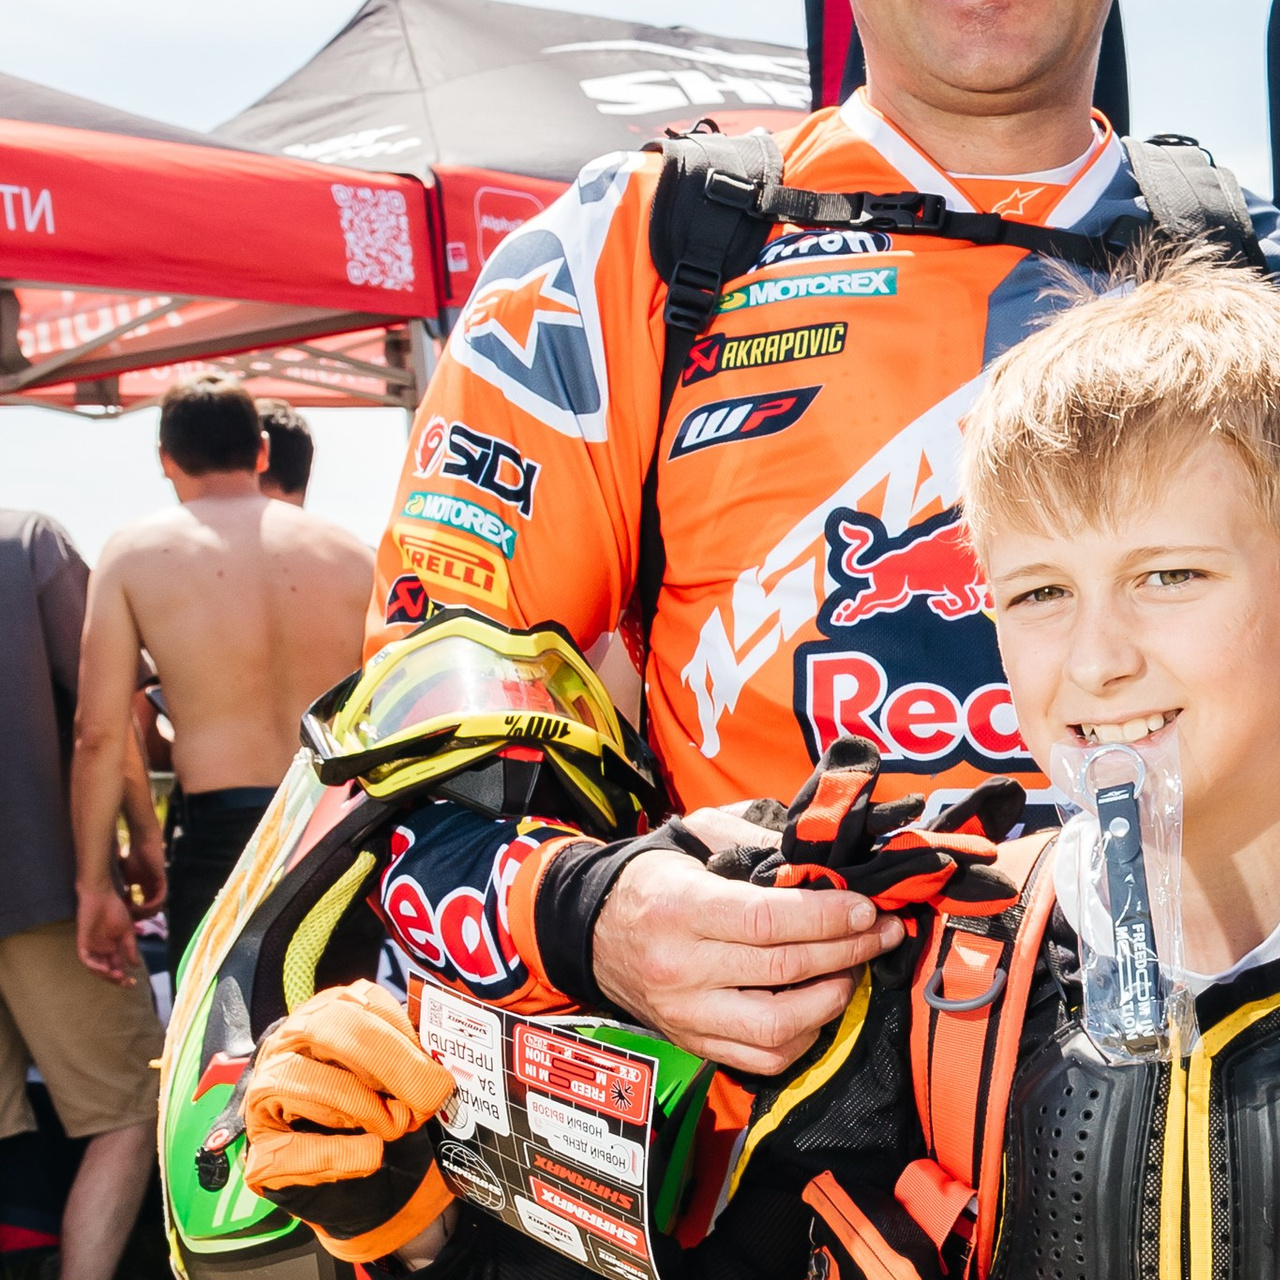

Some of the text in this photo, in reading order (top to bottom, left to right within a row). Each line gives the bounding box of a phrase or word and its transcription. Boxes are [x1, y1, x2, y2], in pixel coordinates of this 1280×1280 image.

[749, 270, 890, 306] MOTOREX
[721, 323, 845, 369] AKRAPOVIČ
[681, 397, 798, 448] WP
[422, 494, 513, 554] MOTOREX
[427, 1030, 494, 1073] ПРЕДЕЛЫ
[478, 1074, 497, 1097] ЗА
[532, 1101, 603, 1139] НОВЫЙ ВЫЗОВ
[563, 1134, 589, 1158] ДЕНЬ
[590, 1147, 627, 1170] НОВЫЙ
[533, 1154, 634, 1210] SHARMAX
[540, 1188, 638, 1246] SHARMAX
